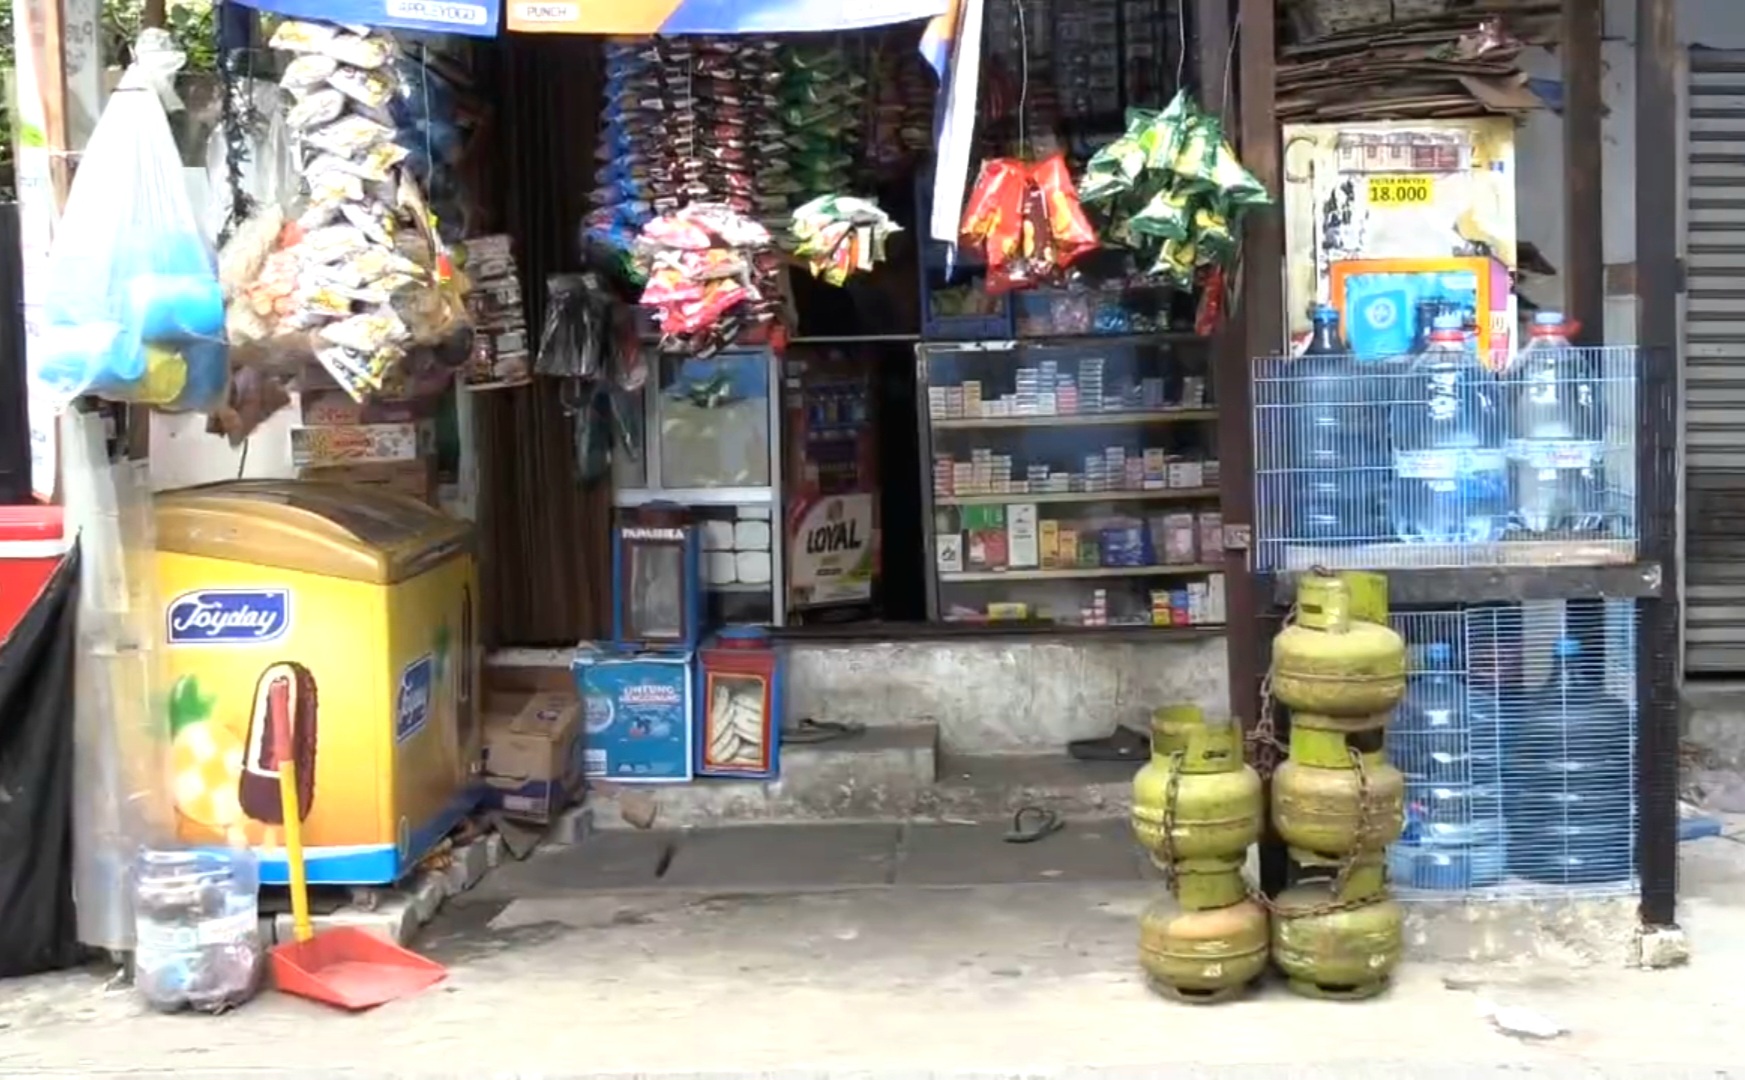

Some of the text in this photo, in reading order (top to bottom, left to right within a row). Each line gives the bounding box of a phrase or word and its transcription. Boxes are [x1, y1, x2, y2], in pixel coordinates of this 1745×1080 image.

[526, 6, 567, 18] PUNCH
[1370, 186, 1427, 202] 18.000
[806, 518, 862, 554] LOYAL
[173, 599, 278, 636] Joyday
